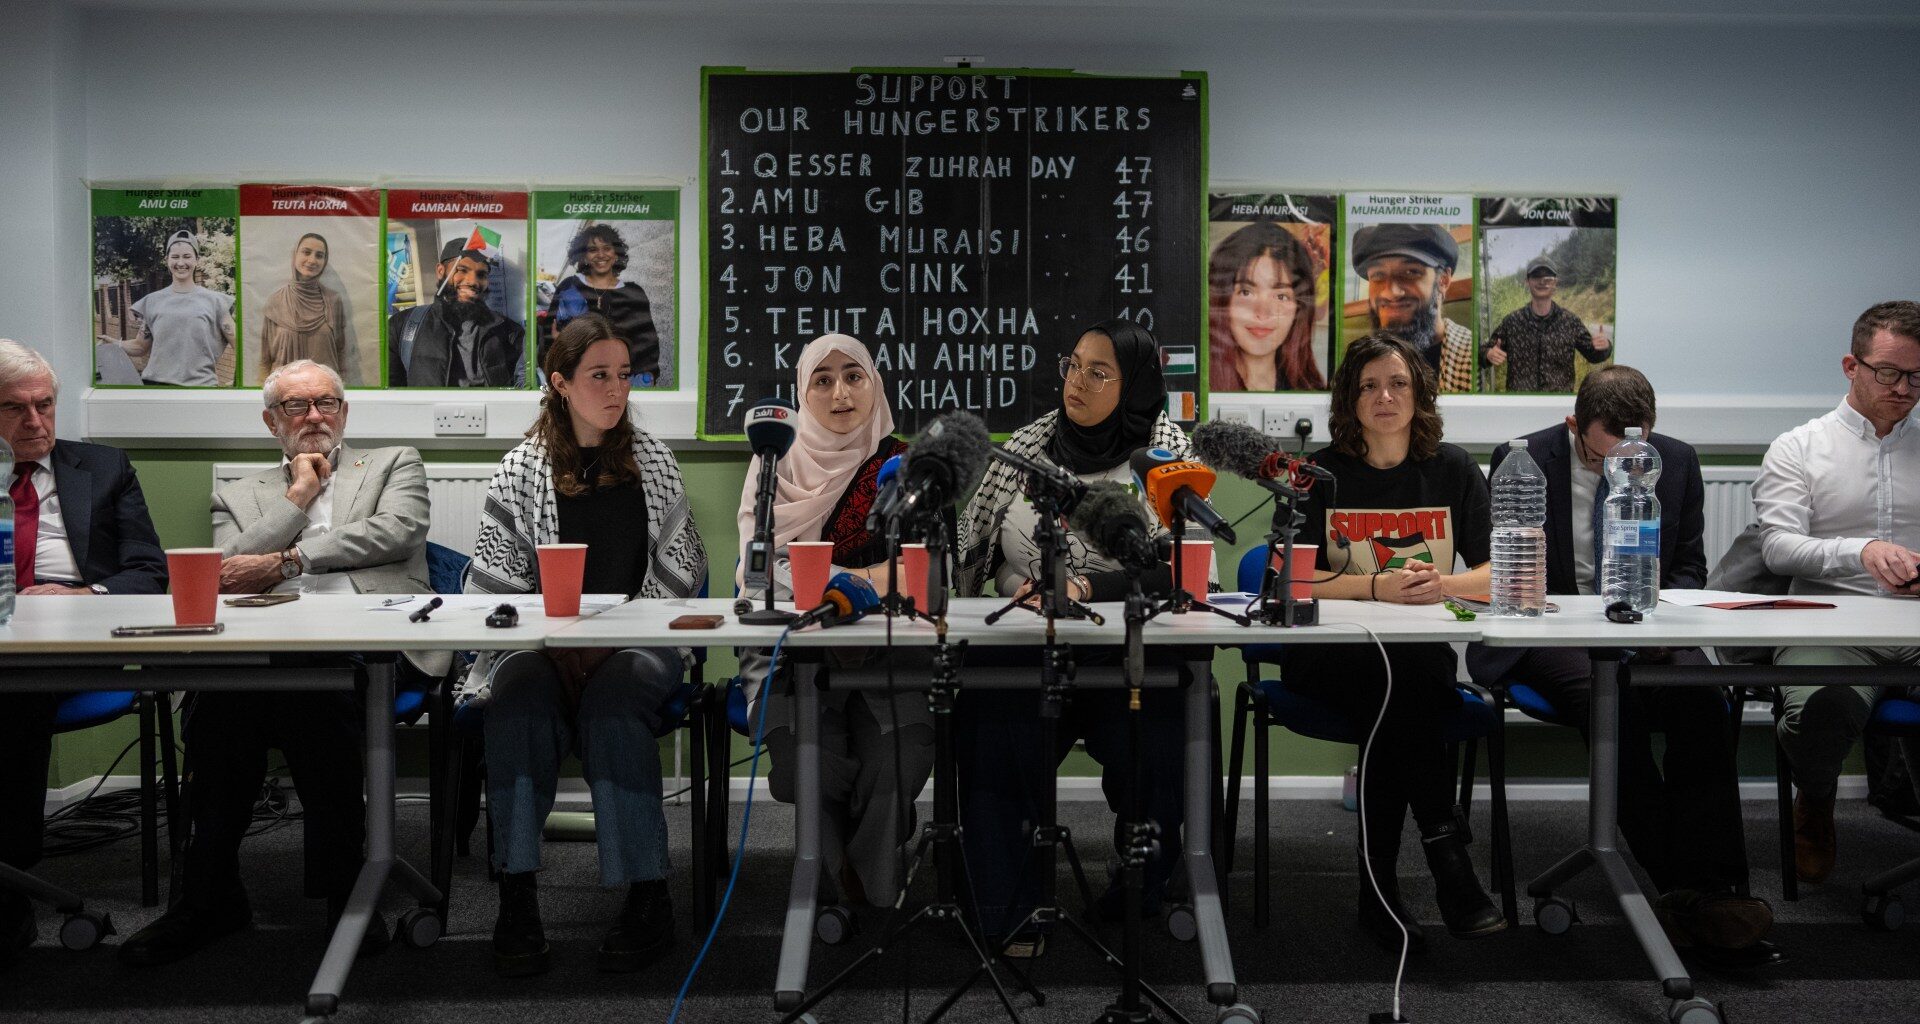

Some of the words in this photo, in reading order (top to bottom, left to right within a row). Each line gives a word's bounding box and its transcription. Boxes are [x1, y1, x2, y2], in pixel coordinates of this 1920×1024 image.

[855, 74, 1017, 105] SUPPORT
[739, 107, 811, 133] OUR
[844, 106, 1151, 136] HUNGERSTRIKERS
[720, 149, 739, 176] 1.
[753, 153, 872, 178] QESSER
[906, 156, 1012, 178] ZUHRAH
[1031, 156, 1076, 180] DAY
[1115, 156, 1152, 184] 47
[419, 191, 459, 202] Hunger
[609, 192, 644, 202] Striker
[1369, 195, 1406, 205] Hunger
[1408, 195, 1443, 204] Striker
[138, 199, 168, 209] AMU
[170, 199, 188, 209] GIB
[272, 200, 307, 209] TEUTA
[308, 200, 348, 210] HOXHA
[411, 203, 461, 213] KAMRAN
[463, 203, 503, 212] AHMED
[720, 187, 744, 214] 2.
[751, 188, 819, 214] AMU
[865, 187, 924, 215] GIB
[1113, 191, 1153, 219] 47
[563, 204, 603, 214] QESSER
[605, 204, 650, 214] ZUHRAH
[1231, 205, 1260, 214] HEBA
[1351, 205, 1420, 216] MUHAMMED
[1422, 206, 1461, 216] KHALID
[1524, 210, 1545, 219] JON
[1546, 209, 1571, 219] CINK
[720, 223, 744, 250] 3.
[759, 225, 847, 251] HEBA
[880, 225, 1020, 254] MURAISI
[1115, 226, 1151, 253] 46
[719, 264, 748, 294] 4.
[764, 265, 842, 293] JON
[880, 263, 968, 293] CINK
[1115, 263, 1153, 293] 41
[725, 306, 750, 333] 5.
[766, 307, 896, 335] TEUTA
[923, 307, 1040, 335] HOXHA
[723, 341, 753, 368] 6.
[934, 343, 1036, 371] AHMED
[1330, 511, 1447, 542] SUPPORT
